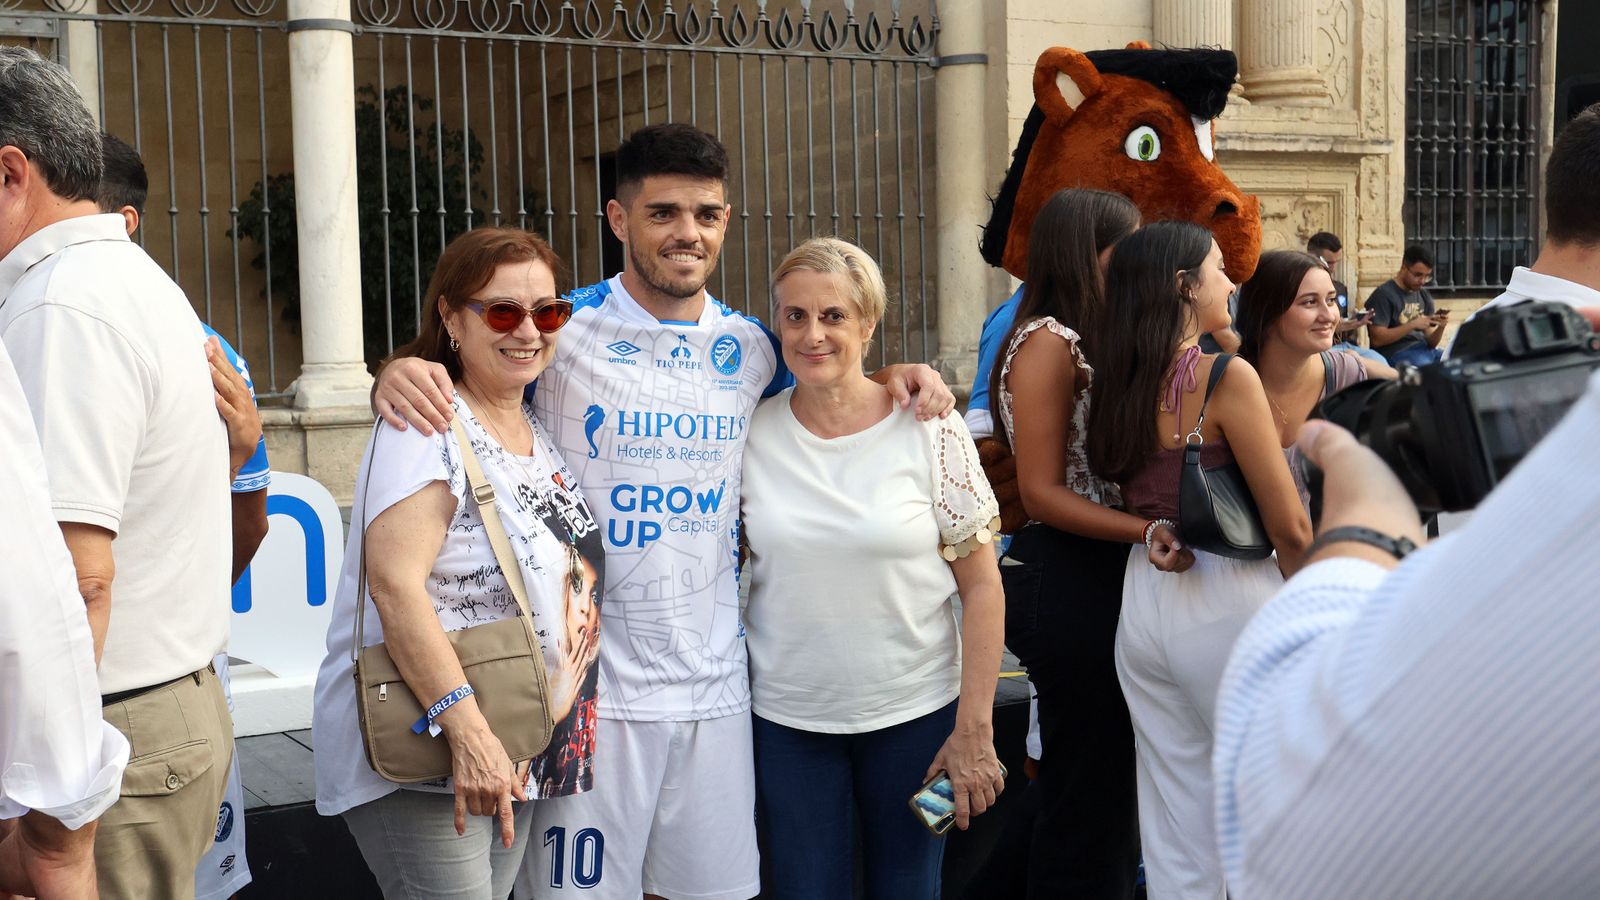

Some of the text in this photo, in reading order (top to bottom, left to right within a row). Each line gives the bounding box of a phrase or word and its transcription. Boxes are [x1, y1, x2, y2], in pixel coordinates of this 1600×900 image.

[608, 356, 637, 366] umbro
[655, 359, 675, 369] TIO
[678, 360, 703, 370] PEPE
[617, 410, 746, 440] HIPOTELS
[617, 444, 722, 462] Hotels & Resorts
[610, 478, 726, 514] GROW
[608, 516, 719, 548] UP Capital
[543, 825, 605, 889] 10
